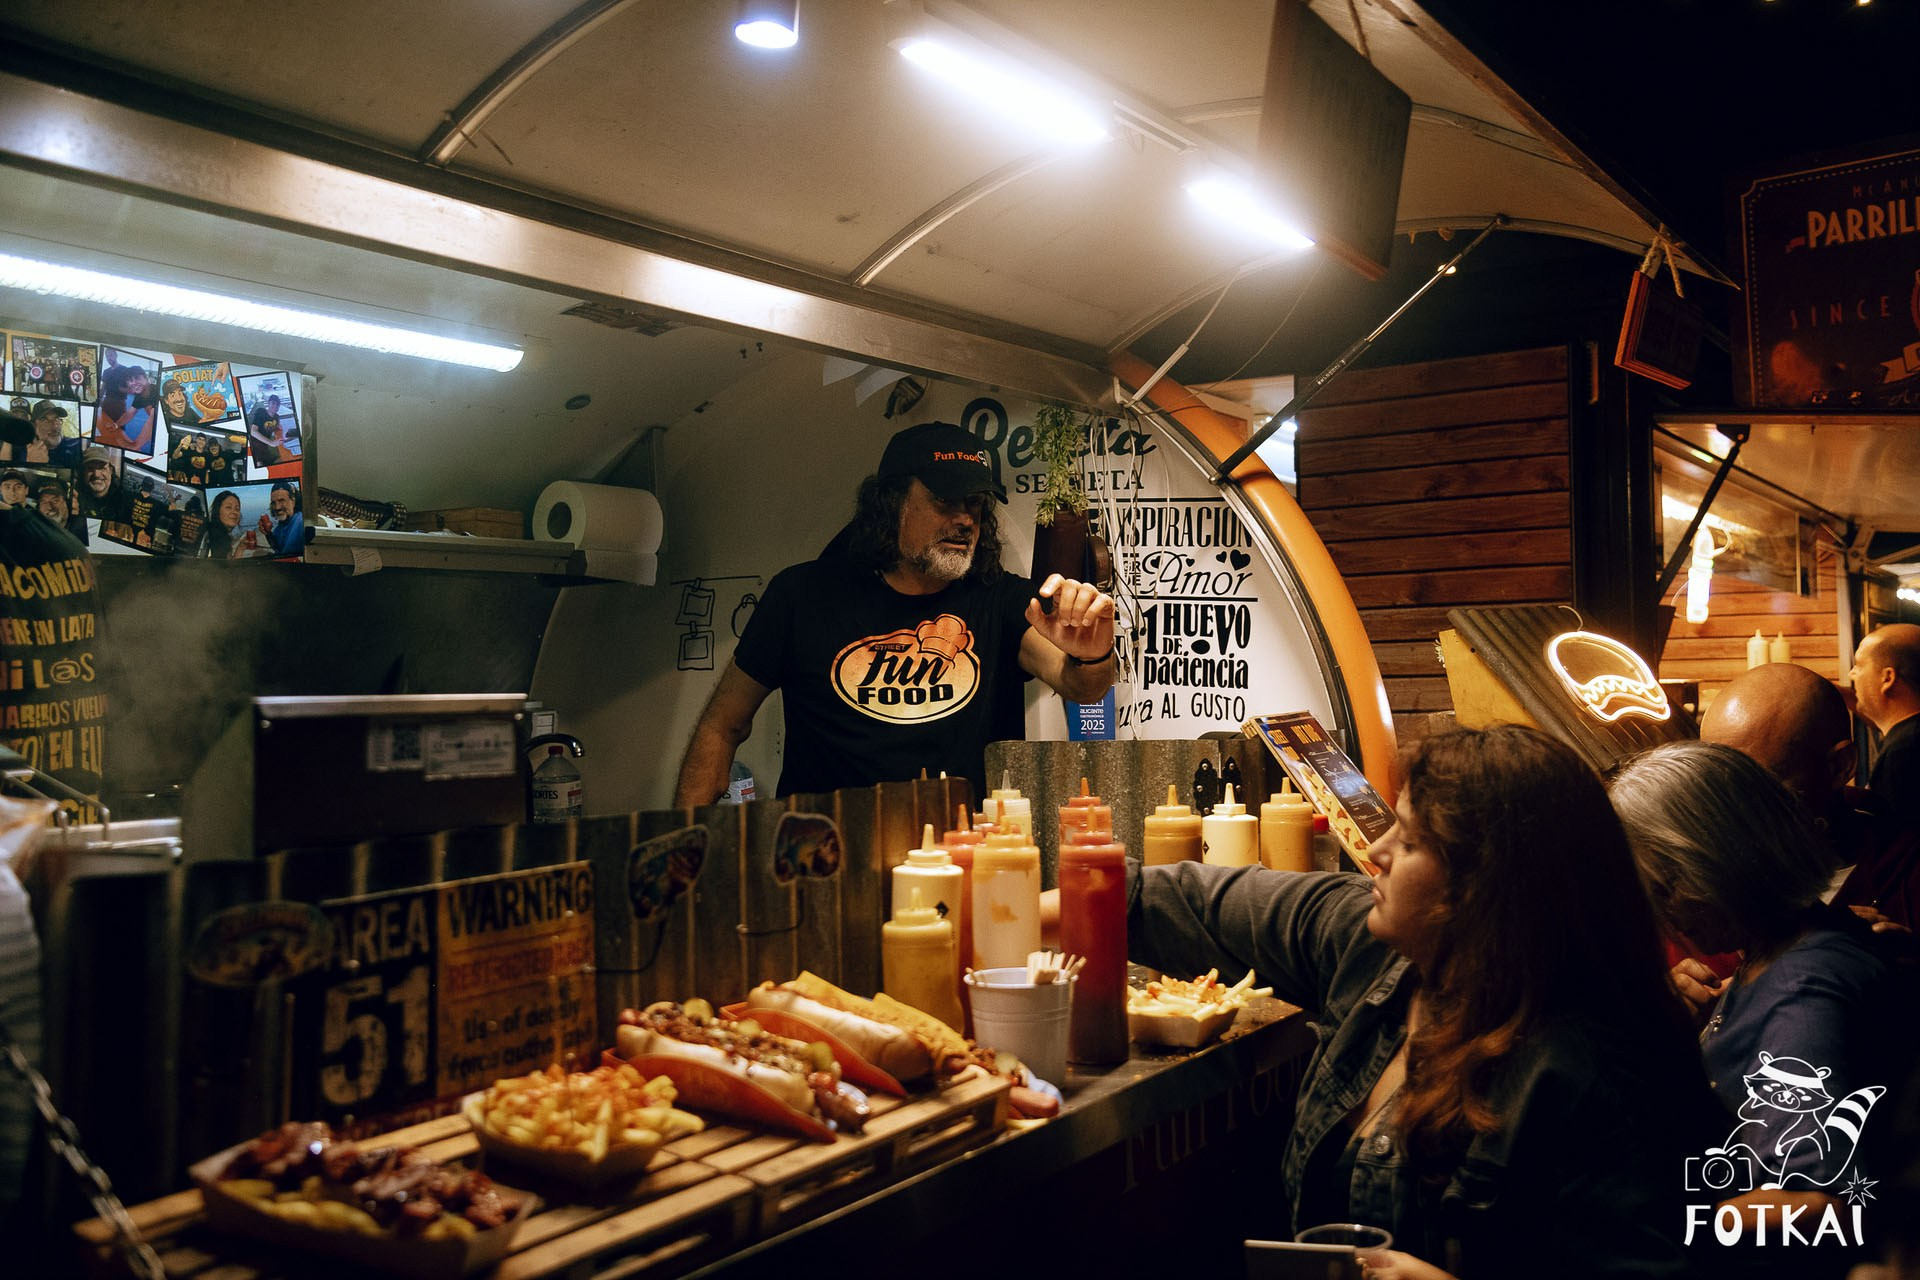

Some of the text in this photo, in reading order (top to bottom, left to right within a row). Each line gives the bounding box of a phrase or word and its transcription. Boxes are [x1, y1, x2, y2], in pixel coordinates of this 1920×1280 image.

[1790, 296, 1891, 330] SINCE
[173, 369, 213, 383] GOLIAT
[933, 451, 955, 461] Fun
[1015, 470, 1144, 494] SEETA
[1140, 551, 1254, 596] Amor
[60, 613, 95, 643] LATA
[1142, 603, 1160, 655] 1
[1163, 603, 1250, 655] HUEVO
[1163, 637, 1183, 655] DE
[857, 648, 949, 687] Fun
[1143, 651, 1249, 690] paciencia
[857, 683, 954, 705] FOOD
[1161, 692, 1181, 719] AL
[1191, 692, 1246, 722] GUSTO
[1080, 719, 1105, 731] 2025
[450, 869, 594, 938] WARNING
[330, 897, 431, 969] AREA
[322, 965, 431, 1106] 51
